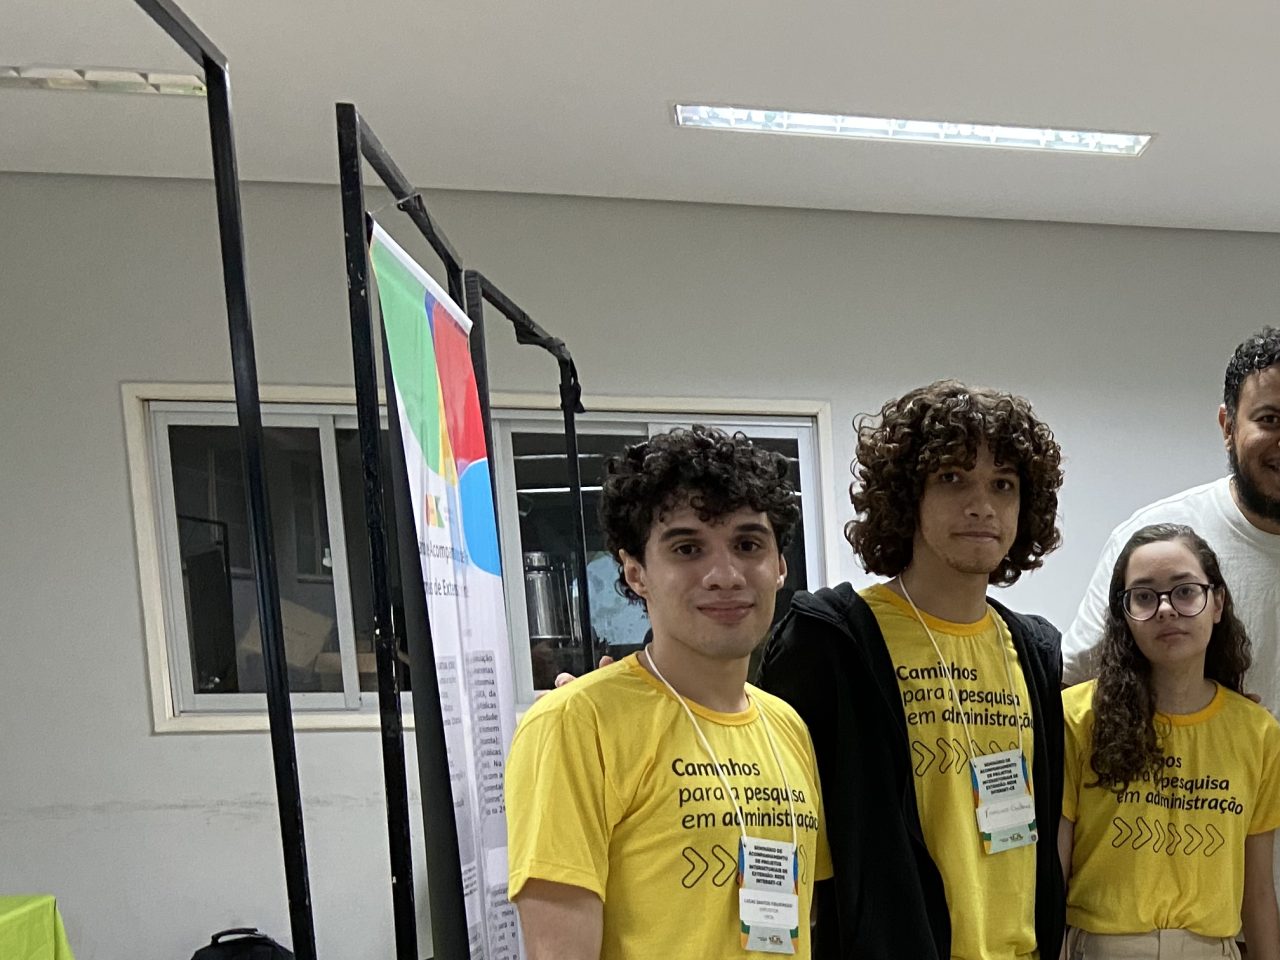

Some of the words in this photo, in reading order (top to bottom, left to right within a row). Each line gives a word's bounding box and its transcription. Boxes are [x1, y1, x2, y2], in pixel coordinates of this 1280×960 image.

[902, 687, 944, 706] para
[959, 688, 1021, 707] pesquisa
[908, 710, 936, 725] em
[1161, 775, 1229, 794] pesquisa
[679, 786, 725, 808] para
[744, 786, 806, 805] pesqusa
[1117, 790, 1140, 804] em
[1145, 790, 1244, 815] administração
[681, 811, 716, 829] em
